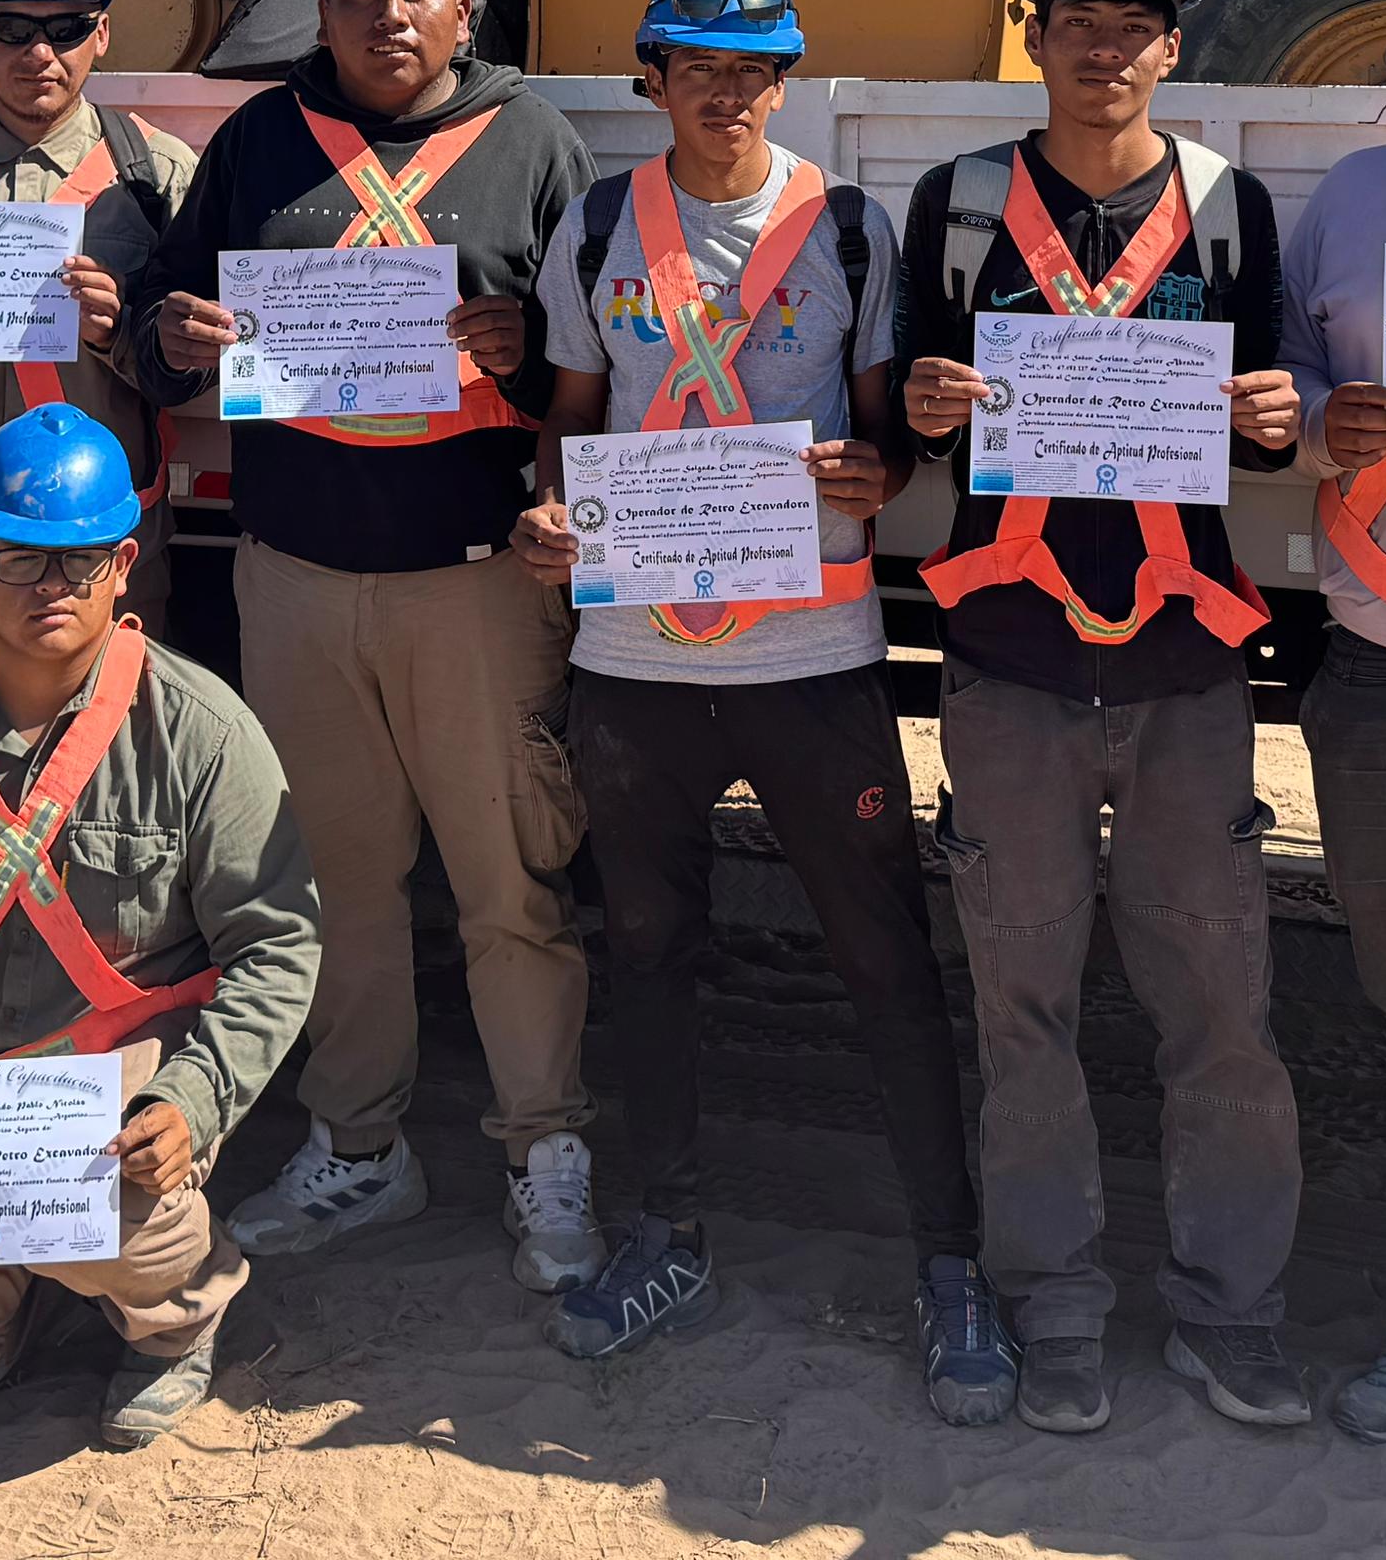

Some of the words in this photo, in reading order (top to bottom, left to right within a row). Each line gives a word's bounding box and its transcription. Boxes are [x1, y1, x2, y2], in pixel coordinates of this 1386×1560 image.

[959, 214, 992, 228] OWEN
[265, 319, 325, 335] Operador
[328, 319, 342, 330] de
[1032, 320, 1104, 353] Certificado
[279, 362, 329, 382] Certificado
[330, 361, 341, 376] de
[1021, 392, 1086, 407] Operador
[1088, 394, 1103, 406] de
[1106, 395, 1146, 410] Retro
[1149, 397, 1223, 412] Excavadora
[617, 433, 686, 468] Certificado
[1033, 437, 1090, 459] Certificado
[1088, 440, 1100, 456] de
[1101, 440, 1144, 462] Aptitud
[1146, 443, 1202, 463] Profesional
[614, 505, 676, 522] Operador
[680, 503, 694, 515] de
[697, 502, 735, 517] Retro
[738, 498, 810, 515] Excavadora
[631, 549, 683, 569] Certificado
[684, 549, 695, 564] de
[697, 546, 738, 567] Aptitud
[739, 543, 794, 565] Profesional
[29, 1196, 90, 1220] Profesional
